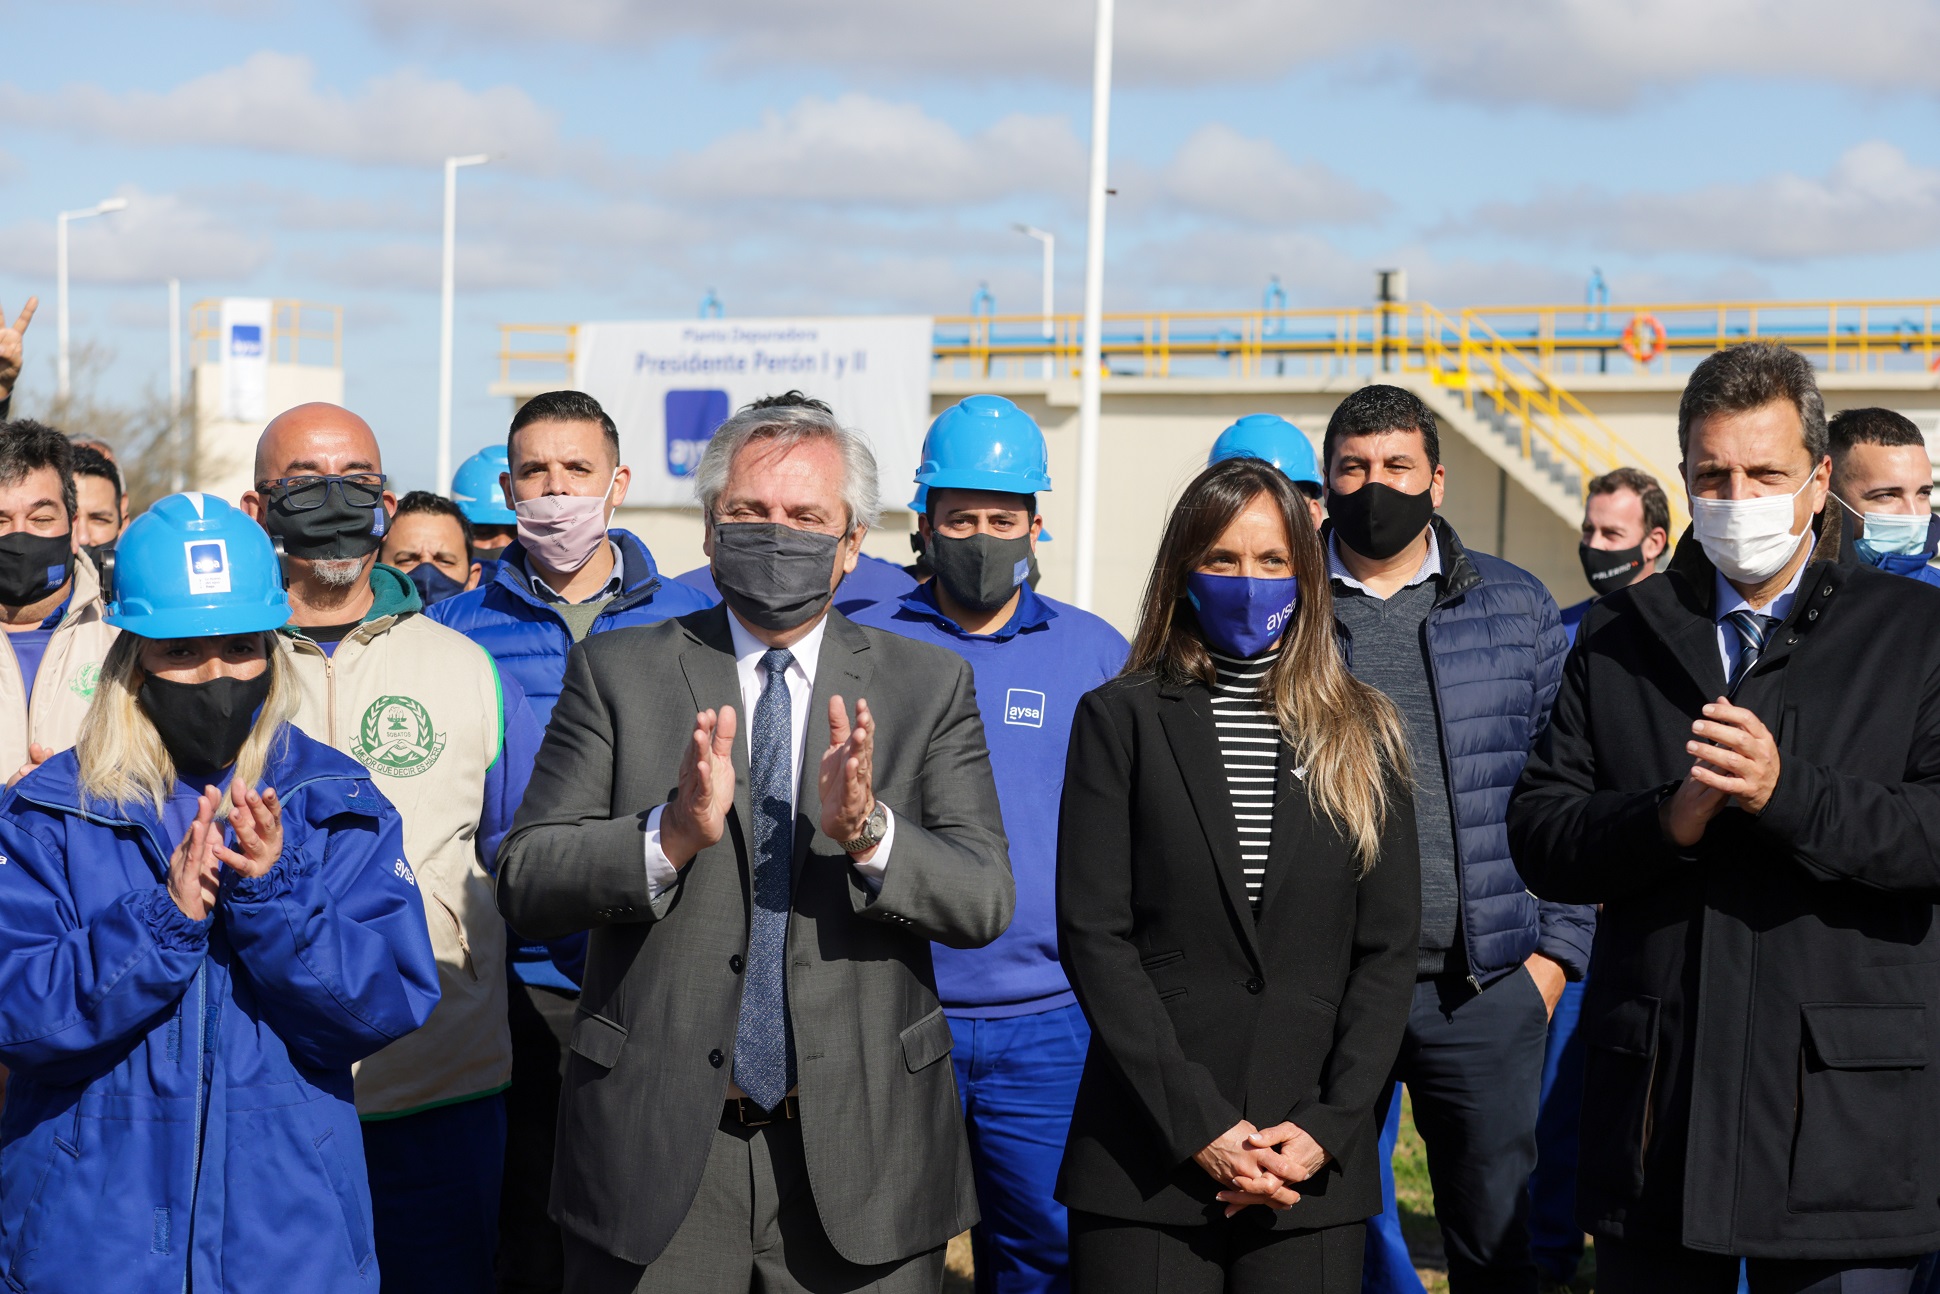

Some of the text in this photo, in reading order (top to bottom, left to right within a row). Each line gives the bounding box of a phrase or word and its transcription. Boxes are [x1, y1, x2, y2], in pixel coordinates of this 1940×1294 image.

[635, 350, 747, 373] Presidente
[753, 348, 817, 373] Perón
[821, 350, 830, 373] I
[833, 354, 848, 380] y
[1592, 562, 1632, 581] PALERMO
[1266, 597, 1297, 631] aysa
[1009, 706, 1040, 720] aysa
[356, 746, 440, 776] MEJOR QUE DECIR ES HACER
[394, 858, 415, 887] aysa
